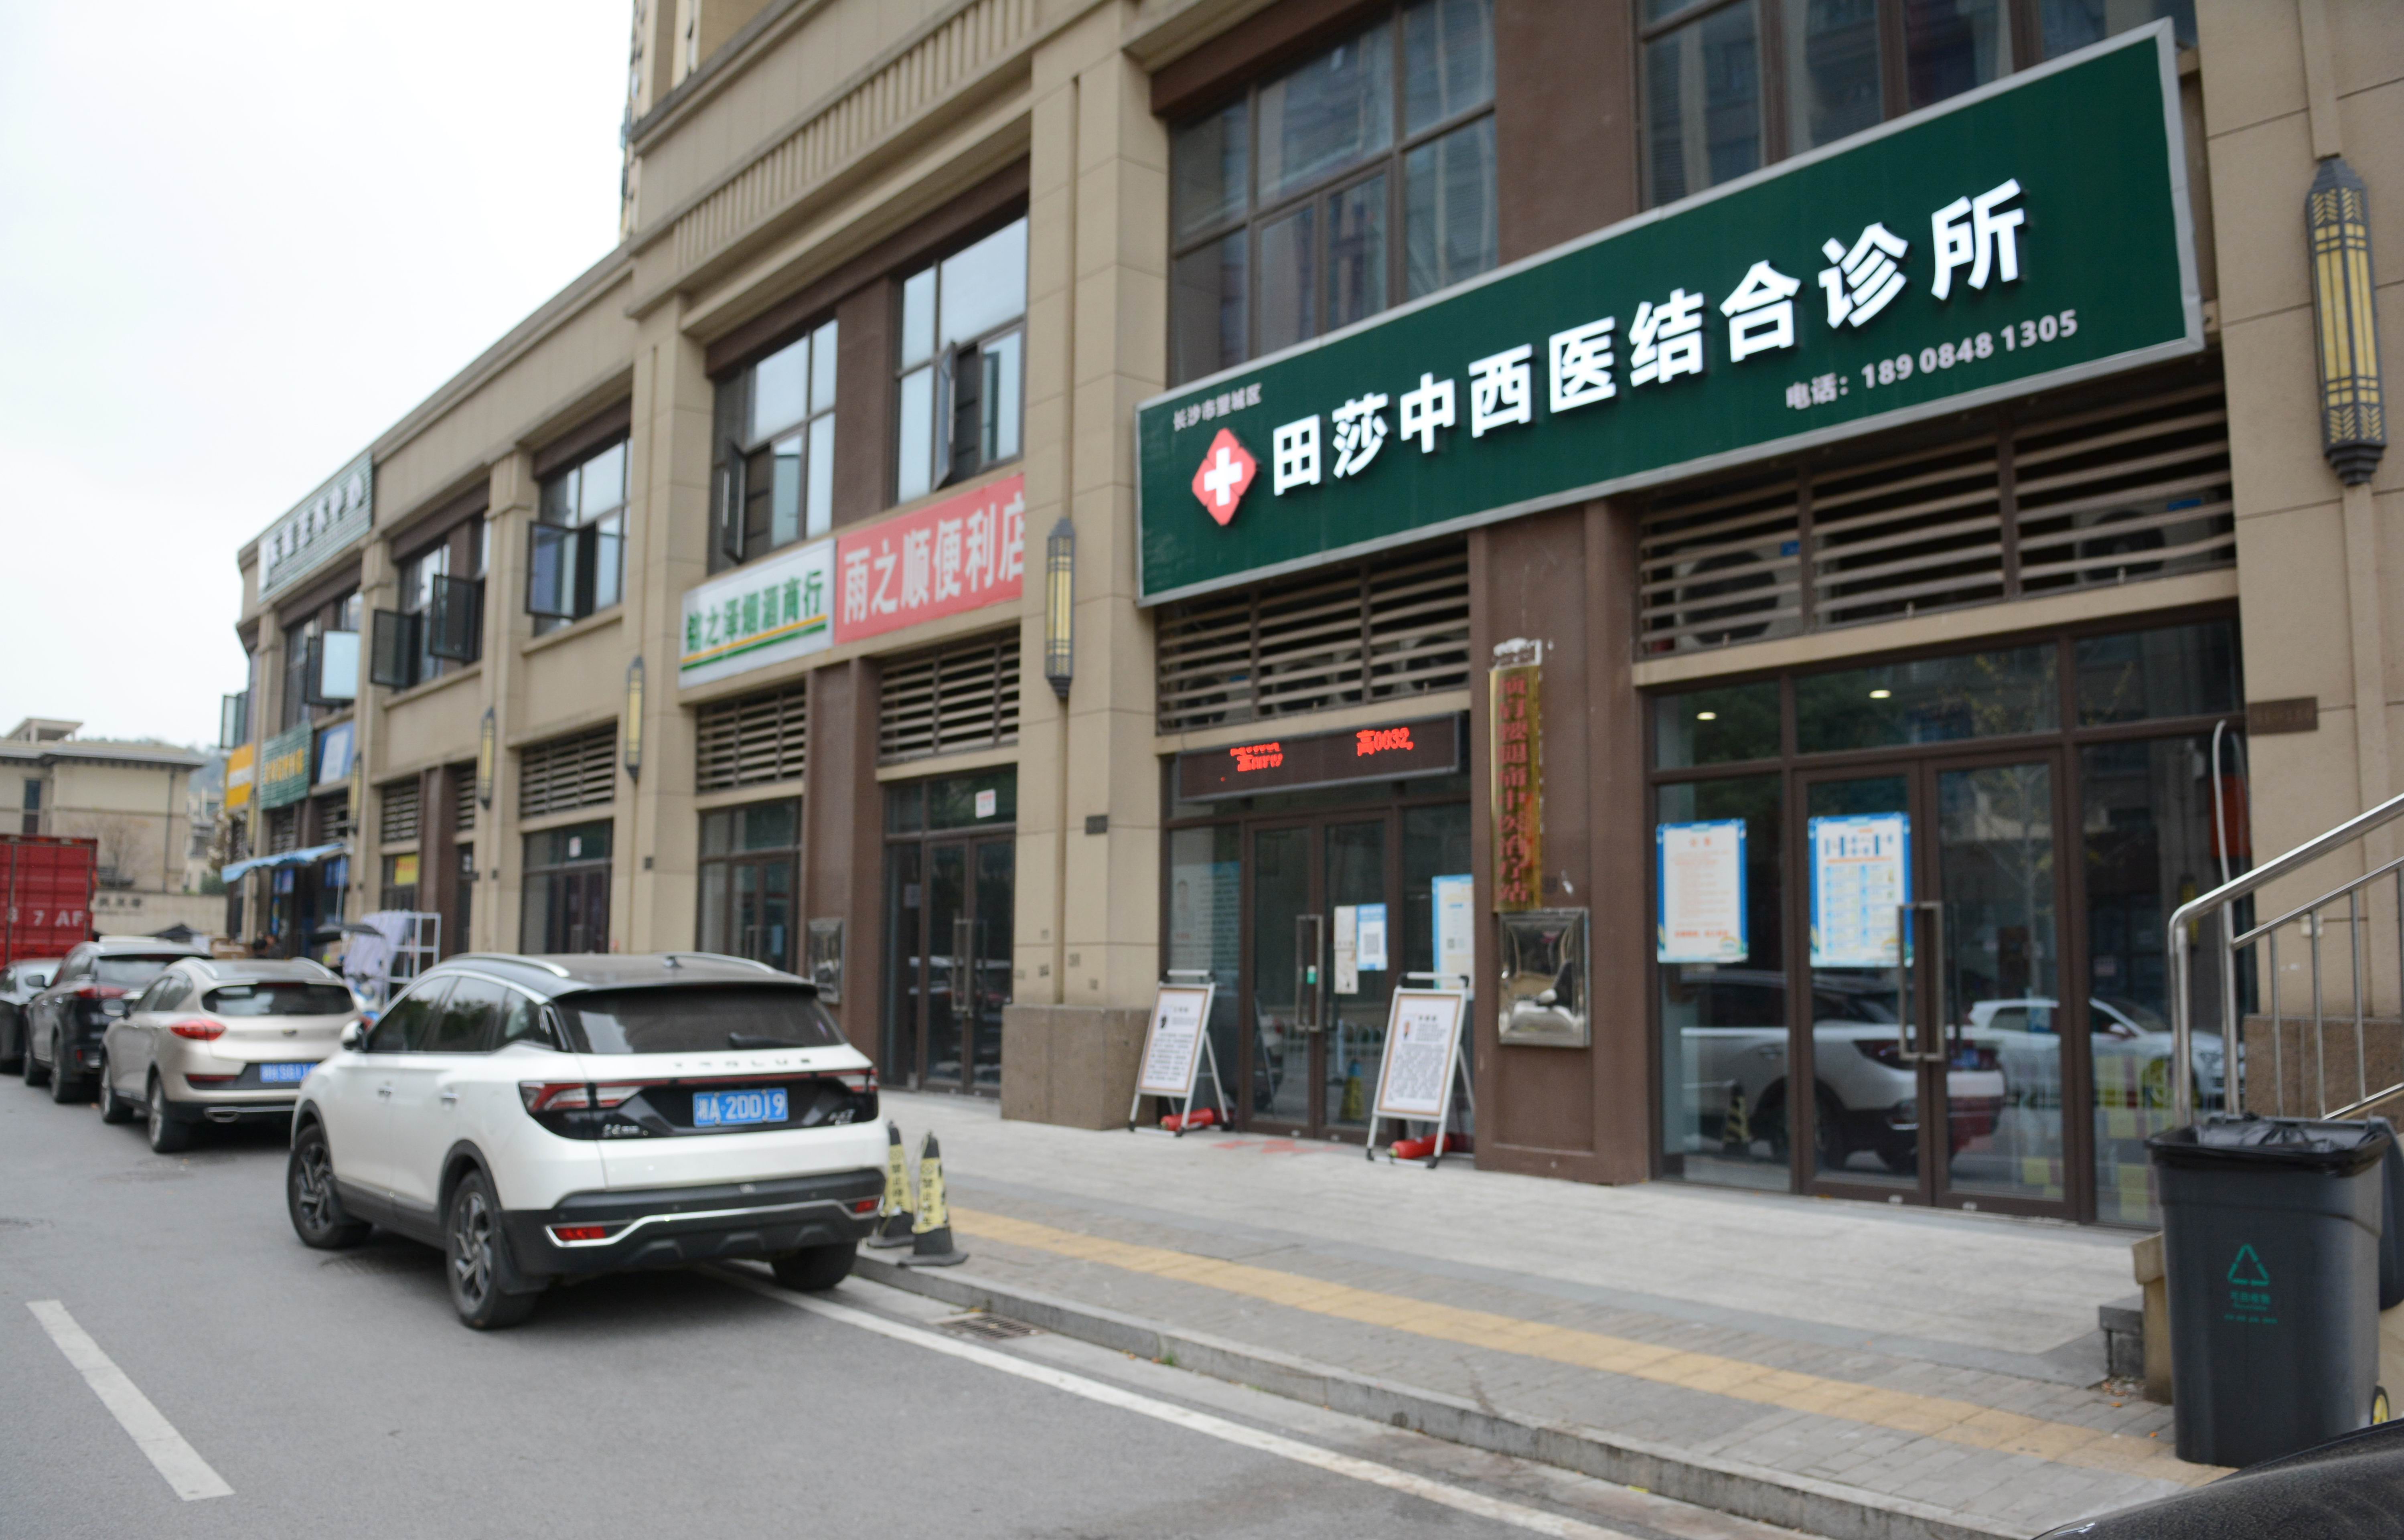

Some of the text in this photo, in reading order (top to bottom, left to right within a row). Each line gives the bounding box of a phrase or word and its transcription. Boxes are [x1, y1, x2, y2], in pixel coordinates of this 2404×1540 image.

[1273, 177, 2025, 496] 田莎中西医结合诊所
[1861, 353, 1914, 389] 189
[1919, 332, 1994, 374] 0848
[2000, 308, 2078, 352] 1305
[1173, 382, 1262, 432] 长沙市望城区
[843, 490, 1025, 625] 雨之顺便利店
